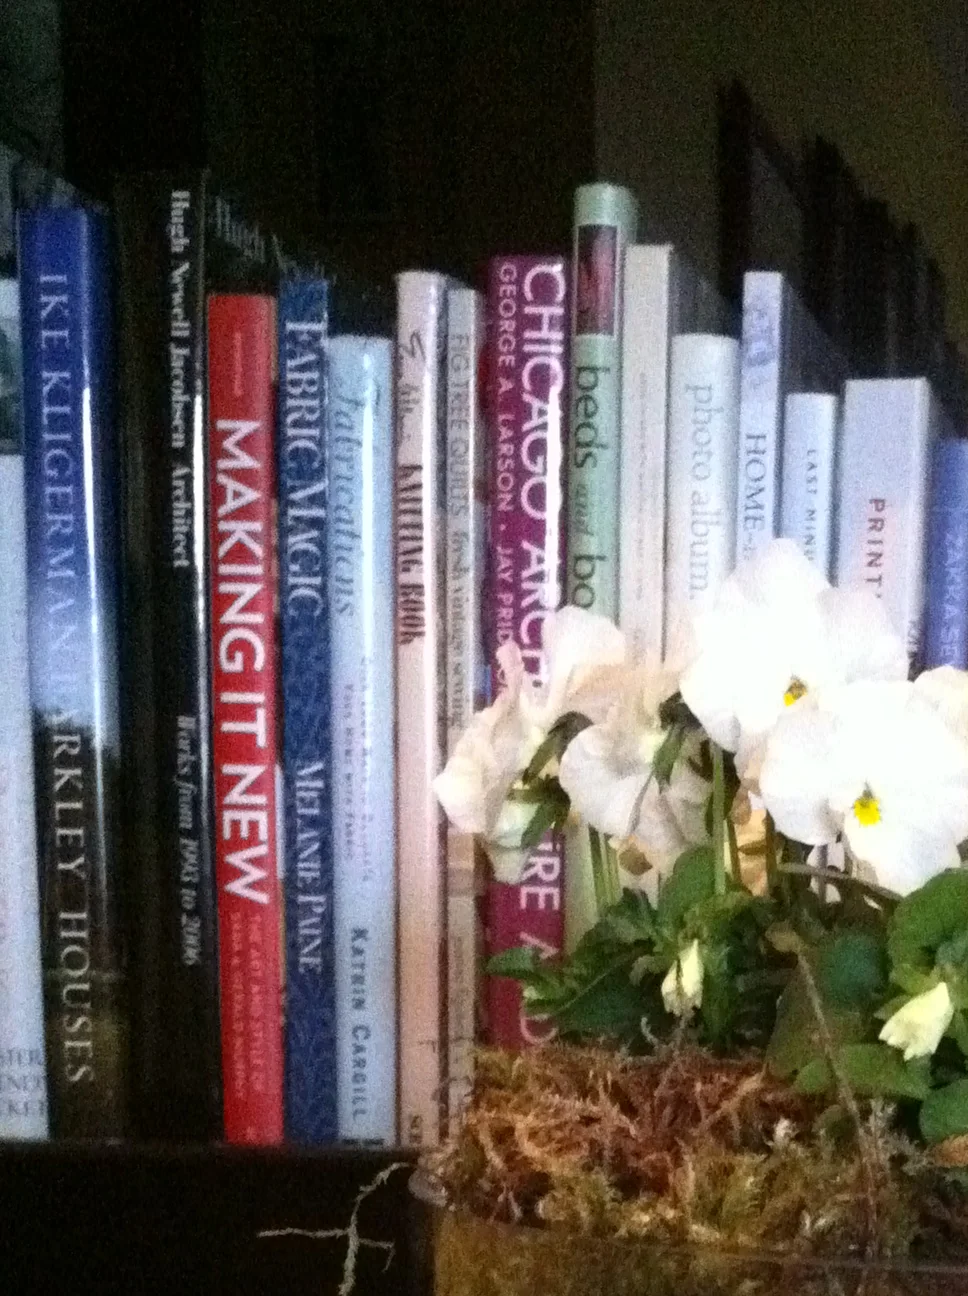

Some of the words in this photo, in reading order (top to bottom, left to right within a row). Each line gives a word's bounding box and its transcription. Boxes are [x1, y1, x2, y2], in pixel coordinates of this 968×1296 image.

[166, 190, 190, 253] Hugh
[40, 272, 68, 351] IKE
[170, 260, 190, 338] Newell
[498, 263, 517, 367] GEORGE
[170, 342, 191, 448] Jacobsen
[285, 318, 326, 469] FABRIC
[520, 264, 565, 521] CHICAGO
[575, 366, 611, 469] beds
[687, 384, 724, 481] photo
[42, 369, 76, 653] KLIGERMAN
[497, 414, 516, 511] LARSON
[806, 449, 818, 495] LAST
[171, 465, 192, 568] Architect
[216, 418, 264, 674] MAKING
[286, 478, 328, 618] MAGIC
[496, 544, 514, 581] JAY
[865, 498, 886, 600] PRINT
[177, 716, 196, 775] Works
[220, 691, 265, 749] IT
[172, 776, 198, 829] from
[221, 763, 269, 905] NEW
[295, 759, 325, 886] MELANIE
[296, 893, 327, 974] PAINE
[348, 928, 370, 1011] KATRIN
[58, 911, 94, 1084] HOUSES
[351, 1025, 373, 1121] CARGILL
